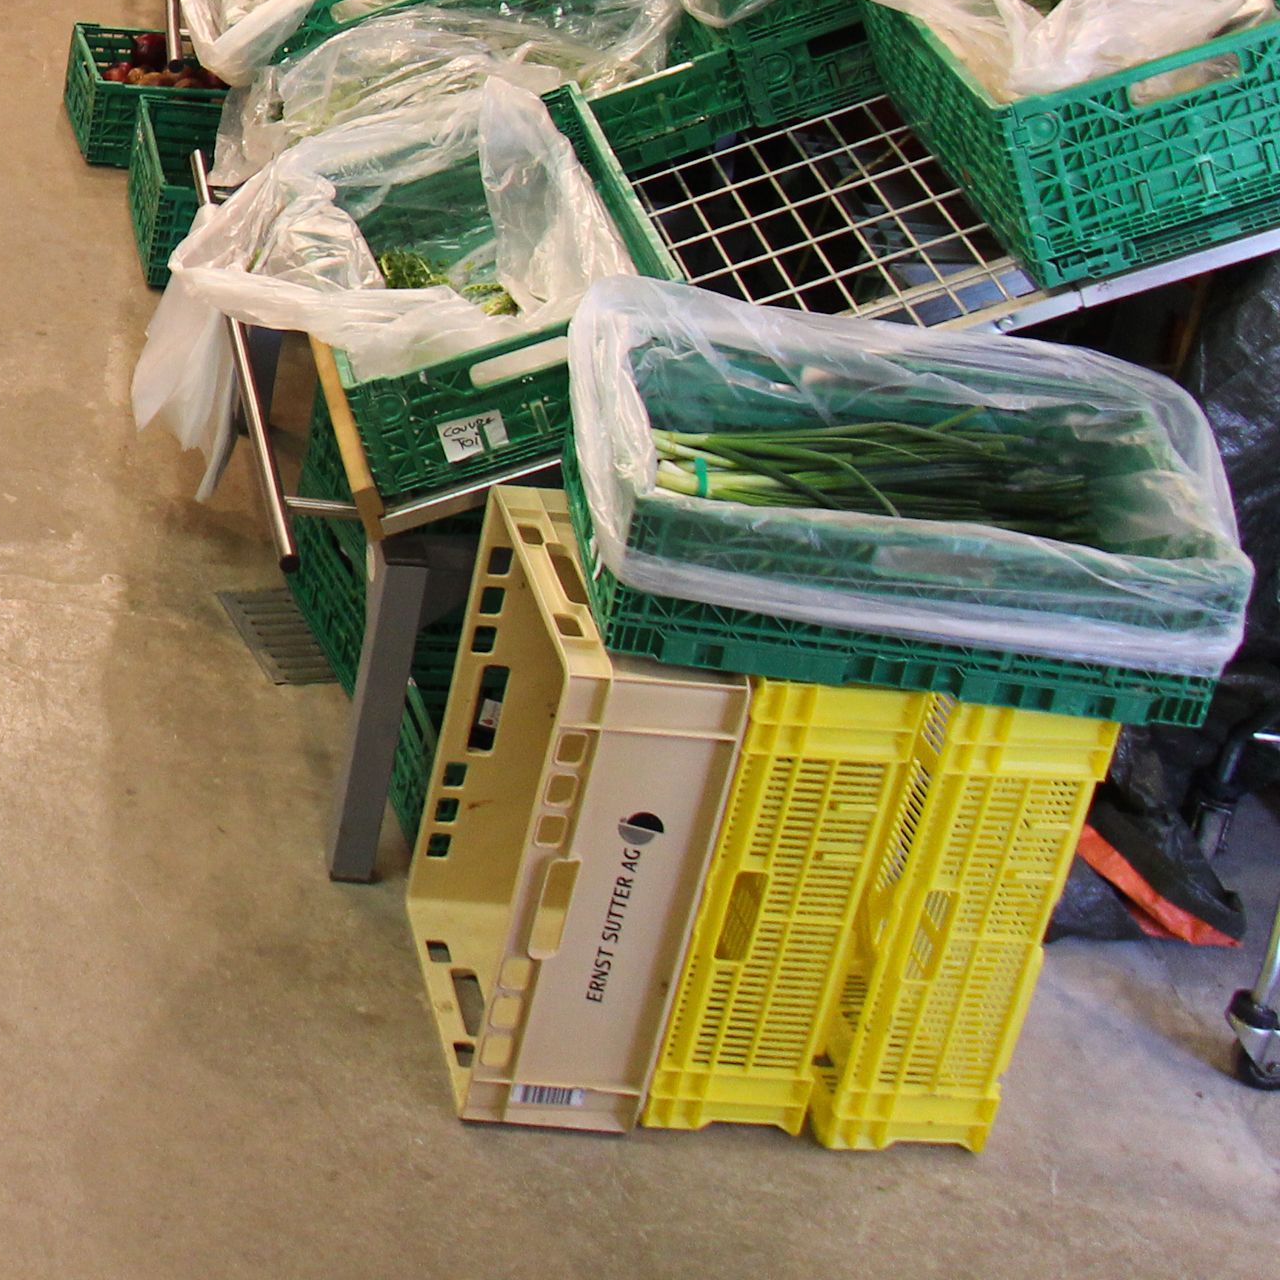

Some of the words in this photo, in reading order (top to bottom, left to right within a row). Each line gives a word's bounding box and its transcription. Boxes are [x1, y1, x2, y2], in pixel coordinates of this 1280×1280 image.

[586, 946, 614, 1004] ERNST
[601, 875, 634, 944] SUTTER
[621, 846, 642, 873] AG
